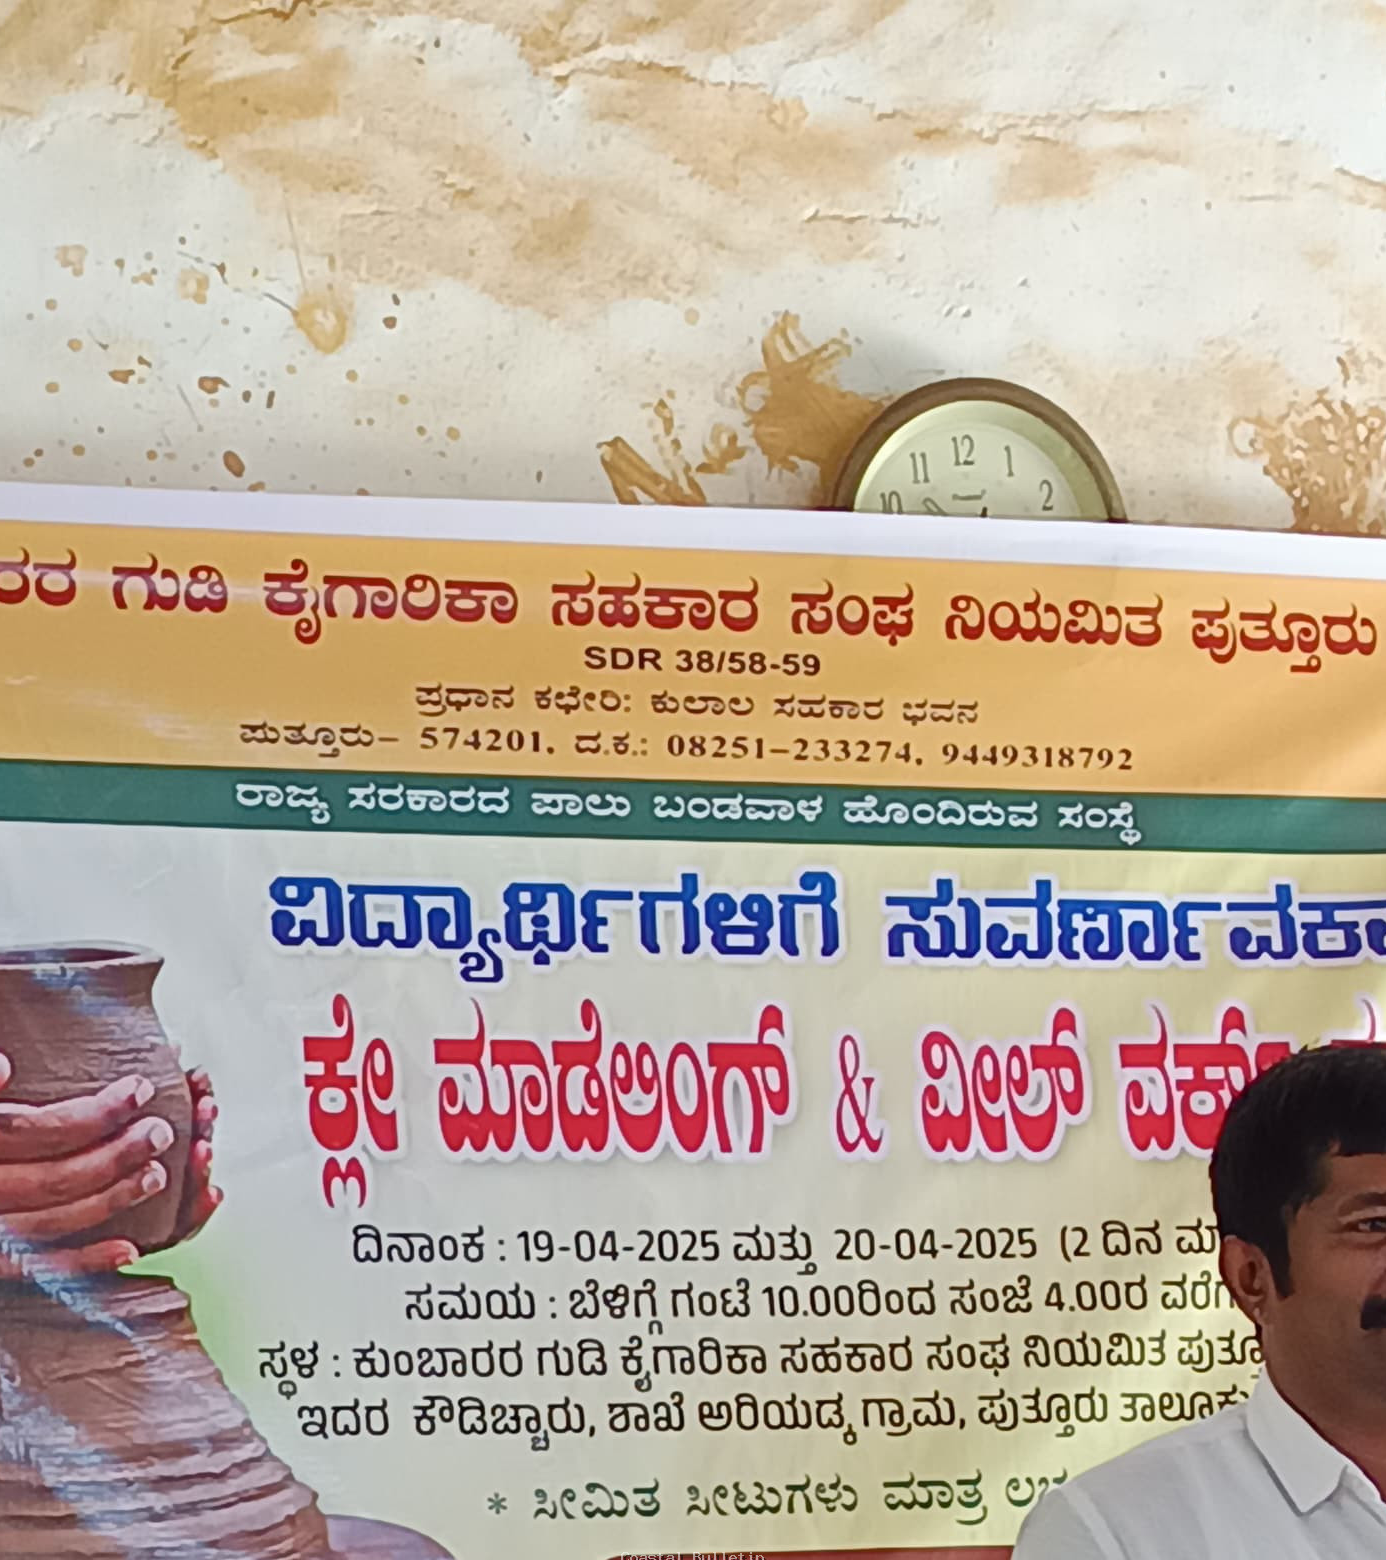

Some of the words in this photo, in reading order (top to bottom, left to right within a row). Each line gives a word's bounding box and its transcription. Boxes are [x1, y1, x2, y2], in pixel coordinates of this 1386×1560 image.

[910, 451, 930, 484] 11
[951, 434, 975, 466] 12
[1005, 445, 1013, 477] 1
[1039, 479, 1054, 511] 2
[113, 551, 227, 612] ಗುಡಿ
[263, 558, 518, 645] ಕೈಗಾರಿಕಾ
[551, 570, 759, 634] ಸಹಕಾರ
[791, 578, 914, 646] ಸಂಘ
[945, 587, 1163, 647] ನಿಯಮಿತ
[1191, 599, 1377, 674] ಪುತ್ತೂರು
[584, 646, 662, 672] SDR
[675, 648, 821, 677] 38/58-59
[415, 682, 515, 717] ಪ್ರಧಾನ
[651, 690, 755, 717] ಕುಲಾಲ
[903, 699, 978, 726] ಭವನ
[941, 743, 1133, 770] 9449318792
[236, 783, 331, 824] ರಾಜ್ಯ
[348, 782, 509, 813] ಸರಕಾರದ
[531, 792, 631, 817] ಪಾಲು
[653, 792, 823, 822] ಬಂಡವಾಳ
[1058, 801, 1142, 845] ಸಂಸ್ಥೆ
[269, 871, 840, 982] ವಿದ್ಯಾರ್ಥಿಗಳಿಗೆ
[303, 993, 399, 1208] ಕ್ಲೇ
[433, 997, 790, 1153] ಮಾಡೆಲಿಂಗ್
[835, 1034, 884, 1153] &
[919, 1007, 1083, 1153] ವೀಲ್
[352, 1224, 484, 1262] ದಿನಾಂಕ
[517, 1229, 721, 1263] 19-04-2025
[733, 1224, 818, 1275] ಮತ್ತು
[834, 1228, 1037, 1260] 20-04-2025
[1060, 1225, 1091, 1262] (2
[1101, 1219, 1162, 1256] ದಿನ
[405, 1282, 535, 1320] ಸಮಯ
[569, 1278, 663, 1335] ಬೆಳಿಗ್ಗೆ
[671, 1277, 750, 1318] ಗಂಟೆ
[761, 1279, 936, 1317] 10.00ರಿಂದ
[949, 1274, 1033, 1315] ಸಂಜೆ
[1044, 1273, 1148, 1312] 4.00ರ
[259, 1340, 319, 1400] ಸ್ಥಳ
[352, 1340, 524, 1378] ಕುಂಬಾರರ
[537, 1338, 608, 1377] ಗುಡಿ
[619, 1335, 767, 1392] ಕೈಗಾರಿಕಾ
[780, 1335, 913, 1374] ಸಹಕಾರ
[926, 1333, 1010, 1377] ಸಂಘ
[1023, 1328, 1166, 1370] ನಿಯಮಿತ
[297, 1397, 389, 1439] ಇದರ
[607, 1391, 685, 1432] ಶಾಖೆ
[862, 1389, 966, 1436] ಗ್ರಾಮ,
[978, 1385, 1108, 1438] ಪುತ್ತೂರು
[533, 1478, 660, 1520] ಸೀಮಿತ
[686, 1473, 858, 1517] ಸೀಟುಗಳು
[883, 1468, 988, 1526] ಮಾತ್ರ
